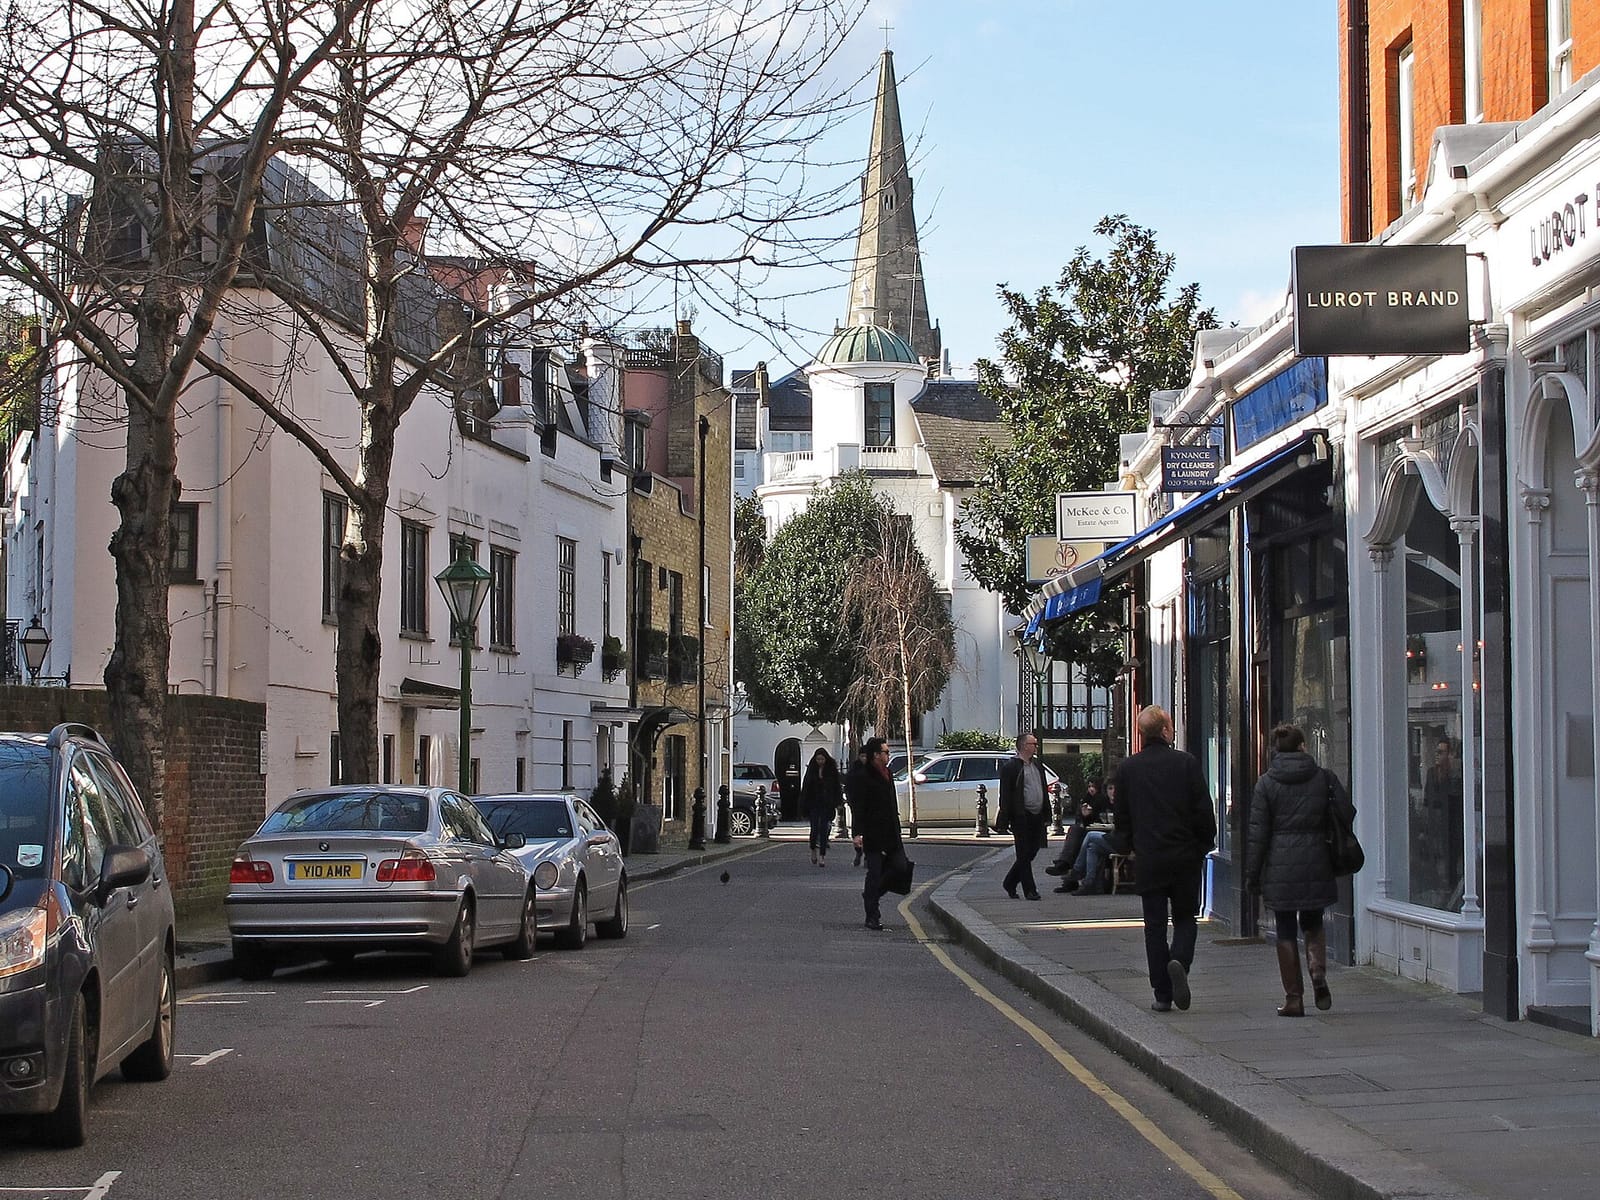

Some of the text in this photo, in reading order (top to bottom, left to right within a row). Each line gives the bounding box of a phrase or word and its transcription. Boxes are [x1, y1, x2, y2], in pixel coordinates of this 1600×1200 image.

[1531, 192, 1588, 267] LUROT
[1307, 291, 1459, 307] LUROT BRAND
[1171, 470, 1210, 478] & LAUNDRY
[1066, 505, 1129, 517] McKee & Co.
[1098, 519, 1119, 527] Agents
[303, 865, 352, 877] Y10 AMR
